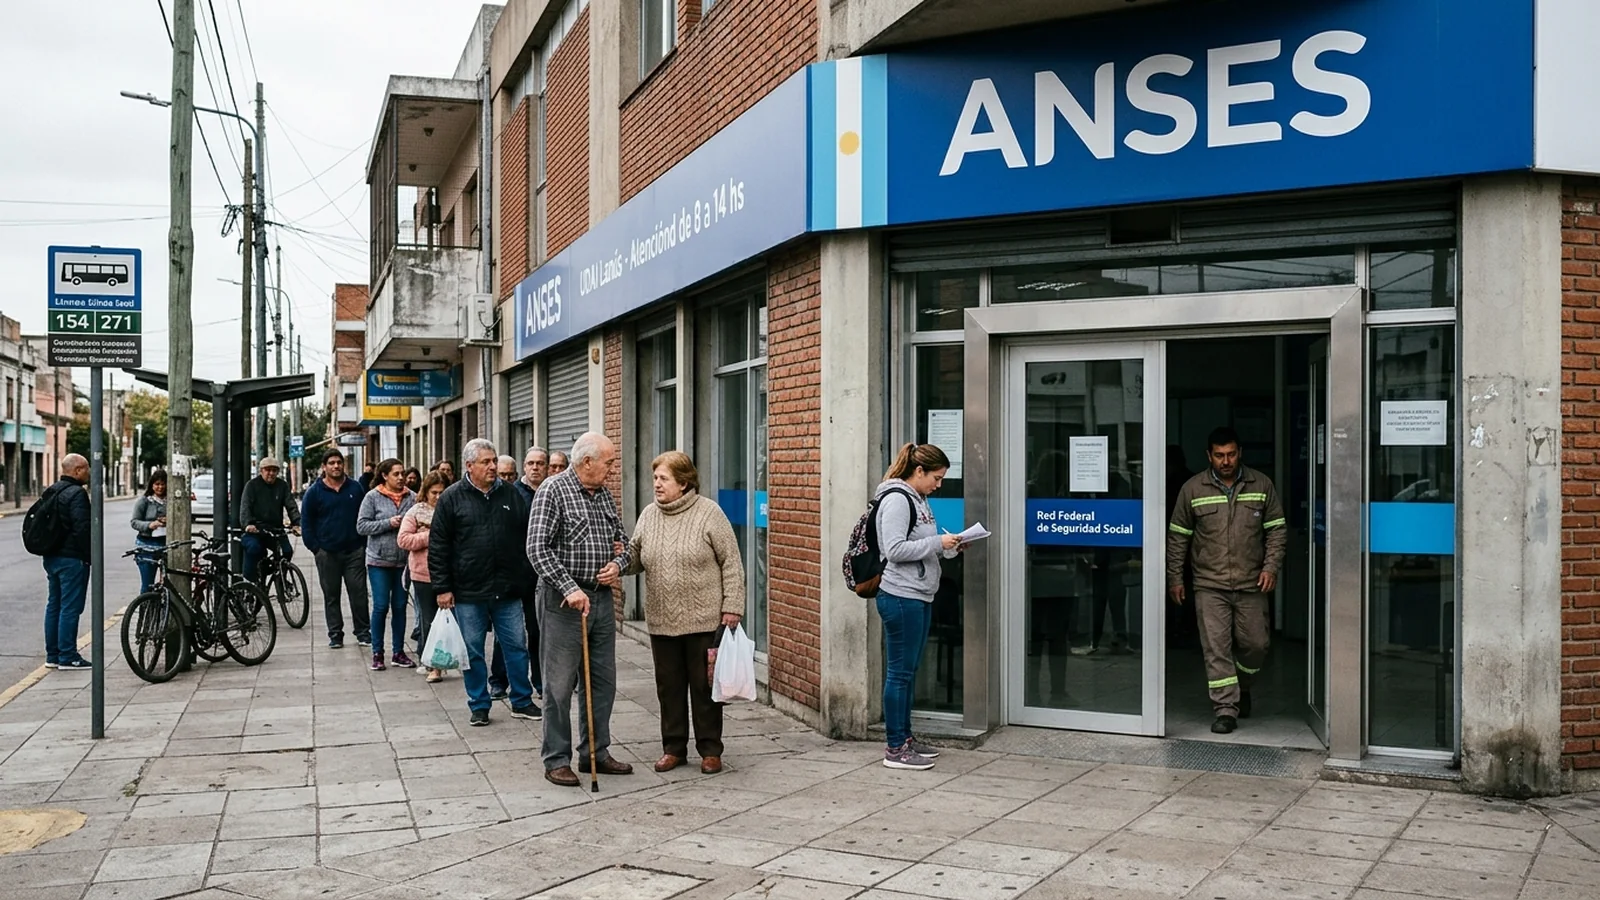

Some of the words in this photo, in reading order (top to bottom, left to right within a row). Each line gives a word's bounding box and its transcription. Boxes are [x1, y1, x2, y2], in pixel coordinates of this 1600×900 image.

[939, 30, 1371, 176] ANSES
[679, 207, 691, 242] de
[694, 200, 701, 234] 8
[704, 202, 710, 229] a
[713, 183, 727, 223] 14
[730, 177, 744, 214] hs
[56, 314, 89, 329] 154
[101, 315, 131, 330] 271
[525, 274, 561, 338] ANSES
[1037, 510, 1056, 521] Red
[1058, 511, 1095, 521] Federal
[1037, 523, 1049, 533] de
[1051, 523, 1101, 535] Seguridad
[1103, 524, 1133, 534] Social
